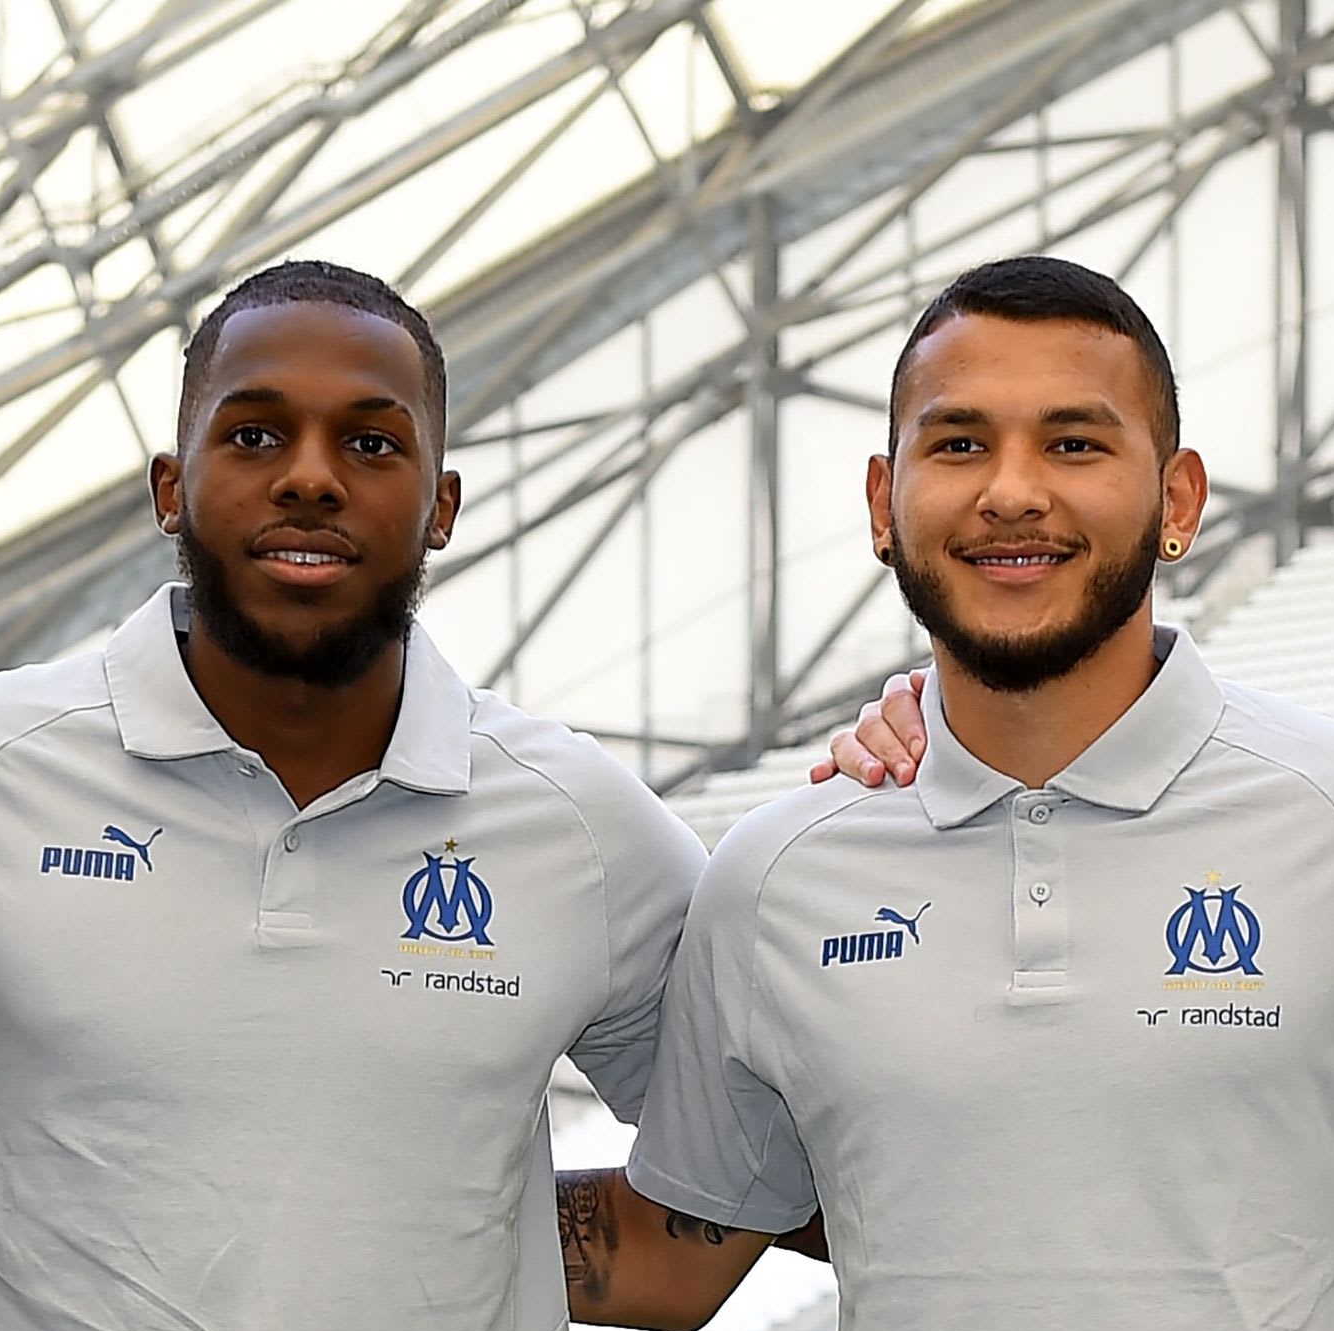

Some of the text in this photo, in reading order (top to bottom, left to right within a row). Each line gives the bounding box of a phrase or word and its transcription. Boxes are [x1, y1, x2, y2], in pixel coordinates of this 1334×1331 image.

[41, 847, 135, 881] PUMA
[822, 931, 904, 967] PUMA
[425, 970, 520, 997] randstad
[1181, 1002, 1281, 1029] randstad
